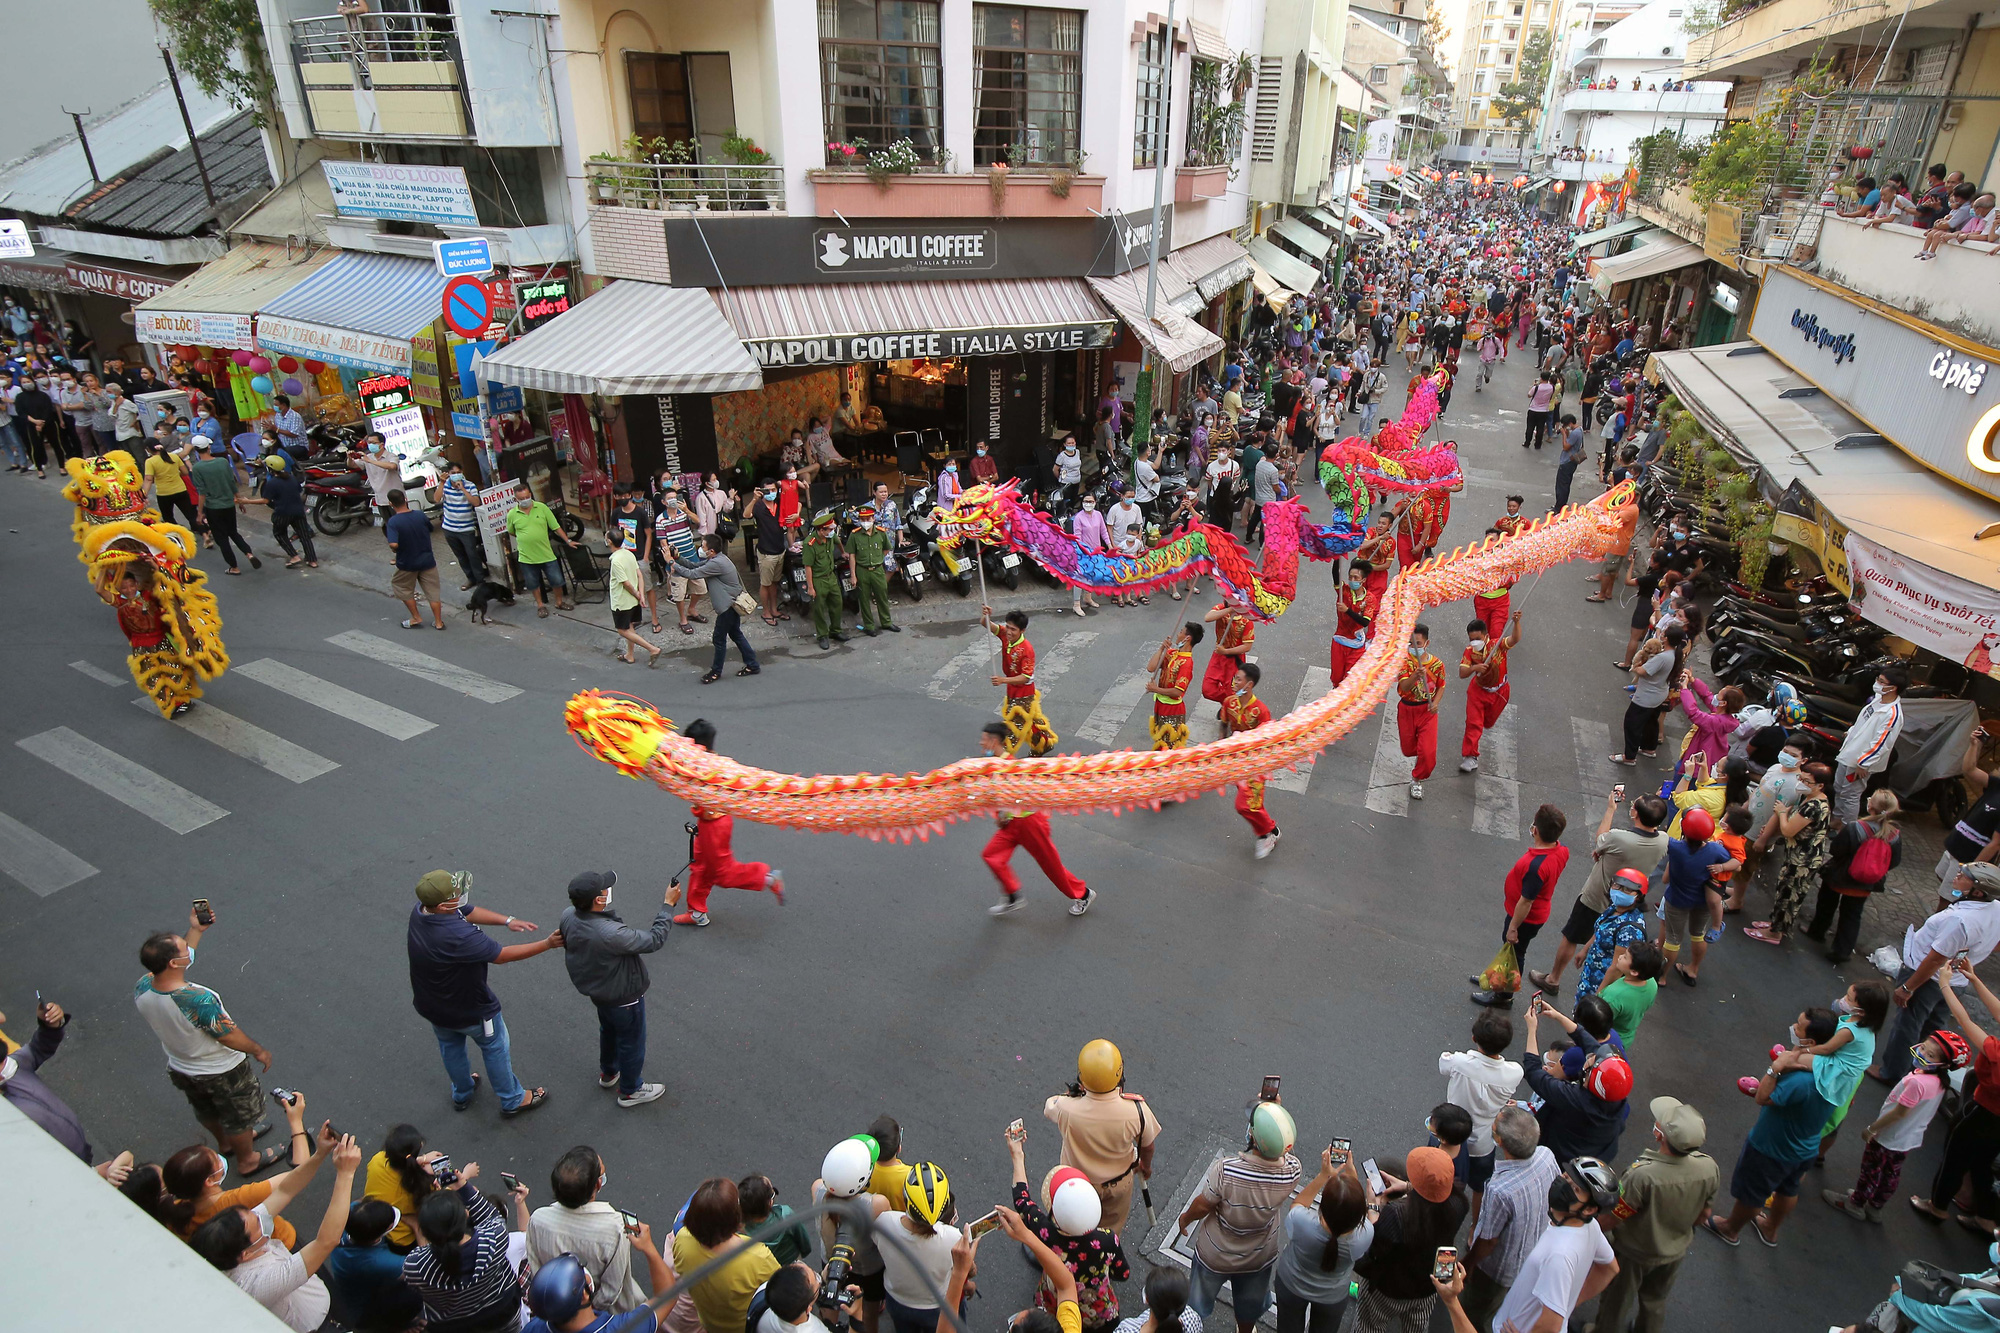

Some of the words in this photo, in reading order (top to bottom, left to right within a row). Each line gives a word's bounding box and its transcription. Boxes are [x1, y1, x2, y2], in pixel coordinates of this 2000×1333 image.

[372, 165, 406, 181] ĐỨC
[408, 168, 466, 184] LƯƠNG
[448, 258, 464, 268] ĐỨC
[464, 257, 486, 267] LƯƠNG
[853, 235, 917, 259] NAPOLI
[921, 235, 984, 258] COFFEE
[525, 298, 554, 319] QUỐC
[555, 296, 569, 312] TẾ
[259, 319, 291, 339] ĐIỆN
[292, 326, 332, 348] THOẠI
[340, 334, 369, 354] MÁY
[371, 339, 408, 362] TÍNH
[755, 338, 843, 366] NAPOLI
[850, 333, 942, 360] COFFEE
[950, 333, 1017, 356] ITALIA
[1022, 330, 1084, 351] STYLE
[990, 368, 1000, 404] COFFEE
[1943, 361, 1988, 395] phê
[374, 416, 394, 430] SỬA
[395, 411, 419, 424] CHỮA
[658, 396, 676, 435] COFFEE
[990, 406, 1000, 440] NAPOLI
[664, 437, 682, 474] NAPOLI
[482, 489, 504, 505] ĐIỂM
[1864, 568, 1894, 588] Quán
[1894, 582, 1922, 600] Phục
[1924, 593, 1940, 611] Vụ
[1942, 601, 1974, 620] Suốt
[1974, 613, 1997, 630] Tết
